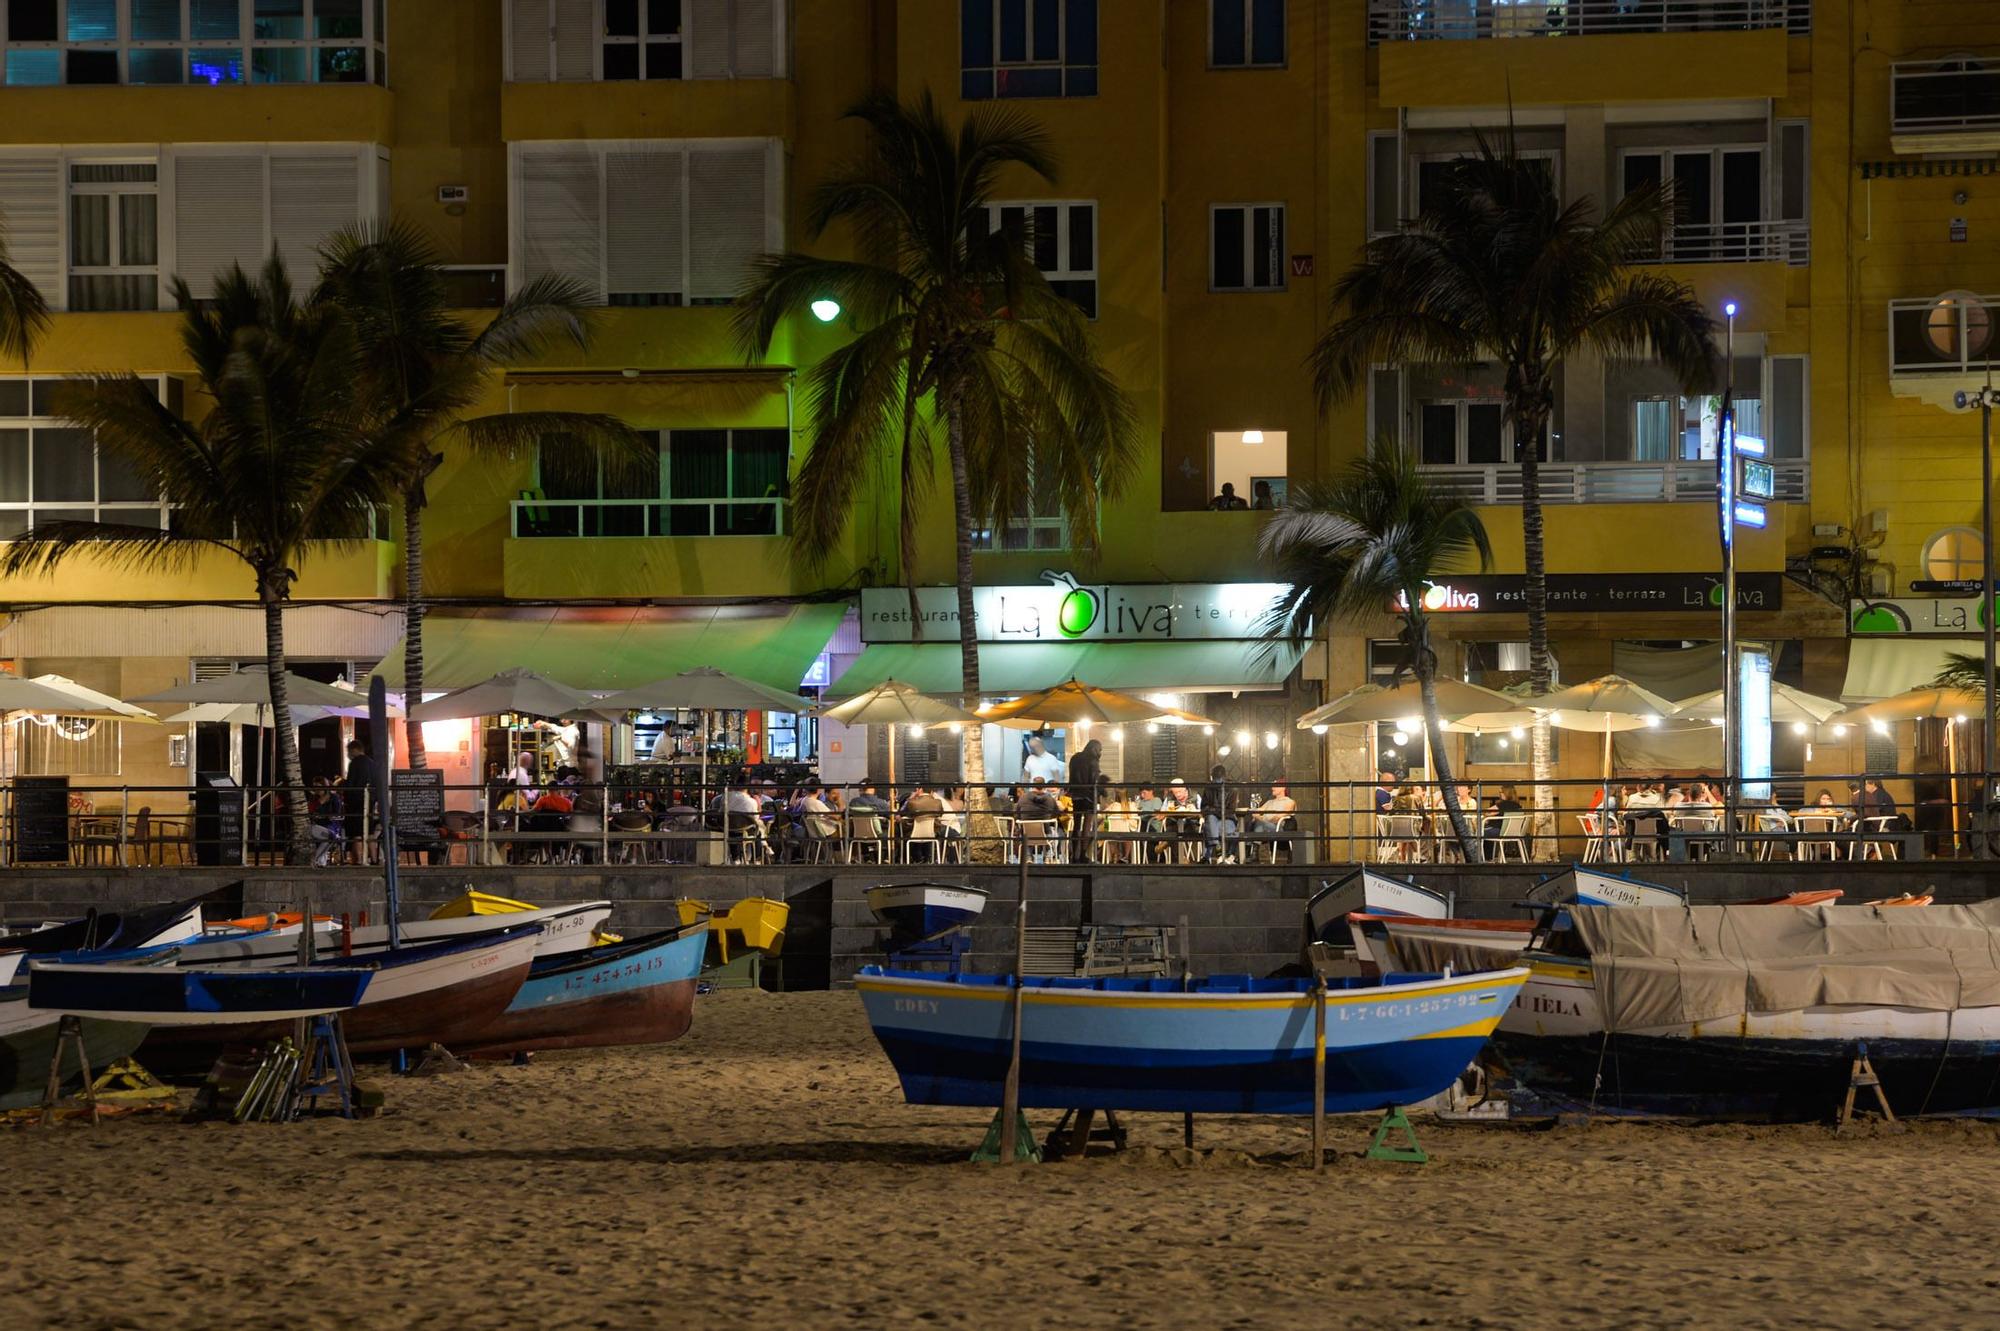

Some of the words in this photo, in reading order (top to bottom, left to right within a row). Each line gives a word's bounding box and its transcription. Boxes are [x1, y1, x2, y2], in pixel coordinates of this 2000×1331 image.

[1400, 588, 1422, 609] L
[1425, 584, 1480, 609] Oliva
[1495, 589, 1588, 601] restrante
[1608, 588, 1667, 600] terraza
[1683, 586, 1704, 607] La
[1709, 583, 1764, 607] Oiva
[872, 607, 980, 622] resturane
[1000, 595, 1041, 638] La
[1059, 586, 1173, 638] Oliva
[1933, 600, 1967, 631] La
[895, 998, 941, 1015] EDEY
